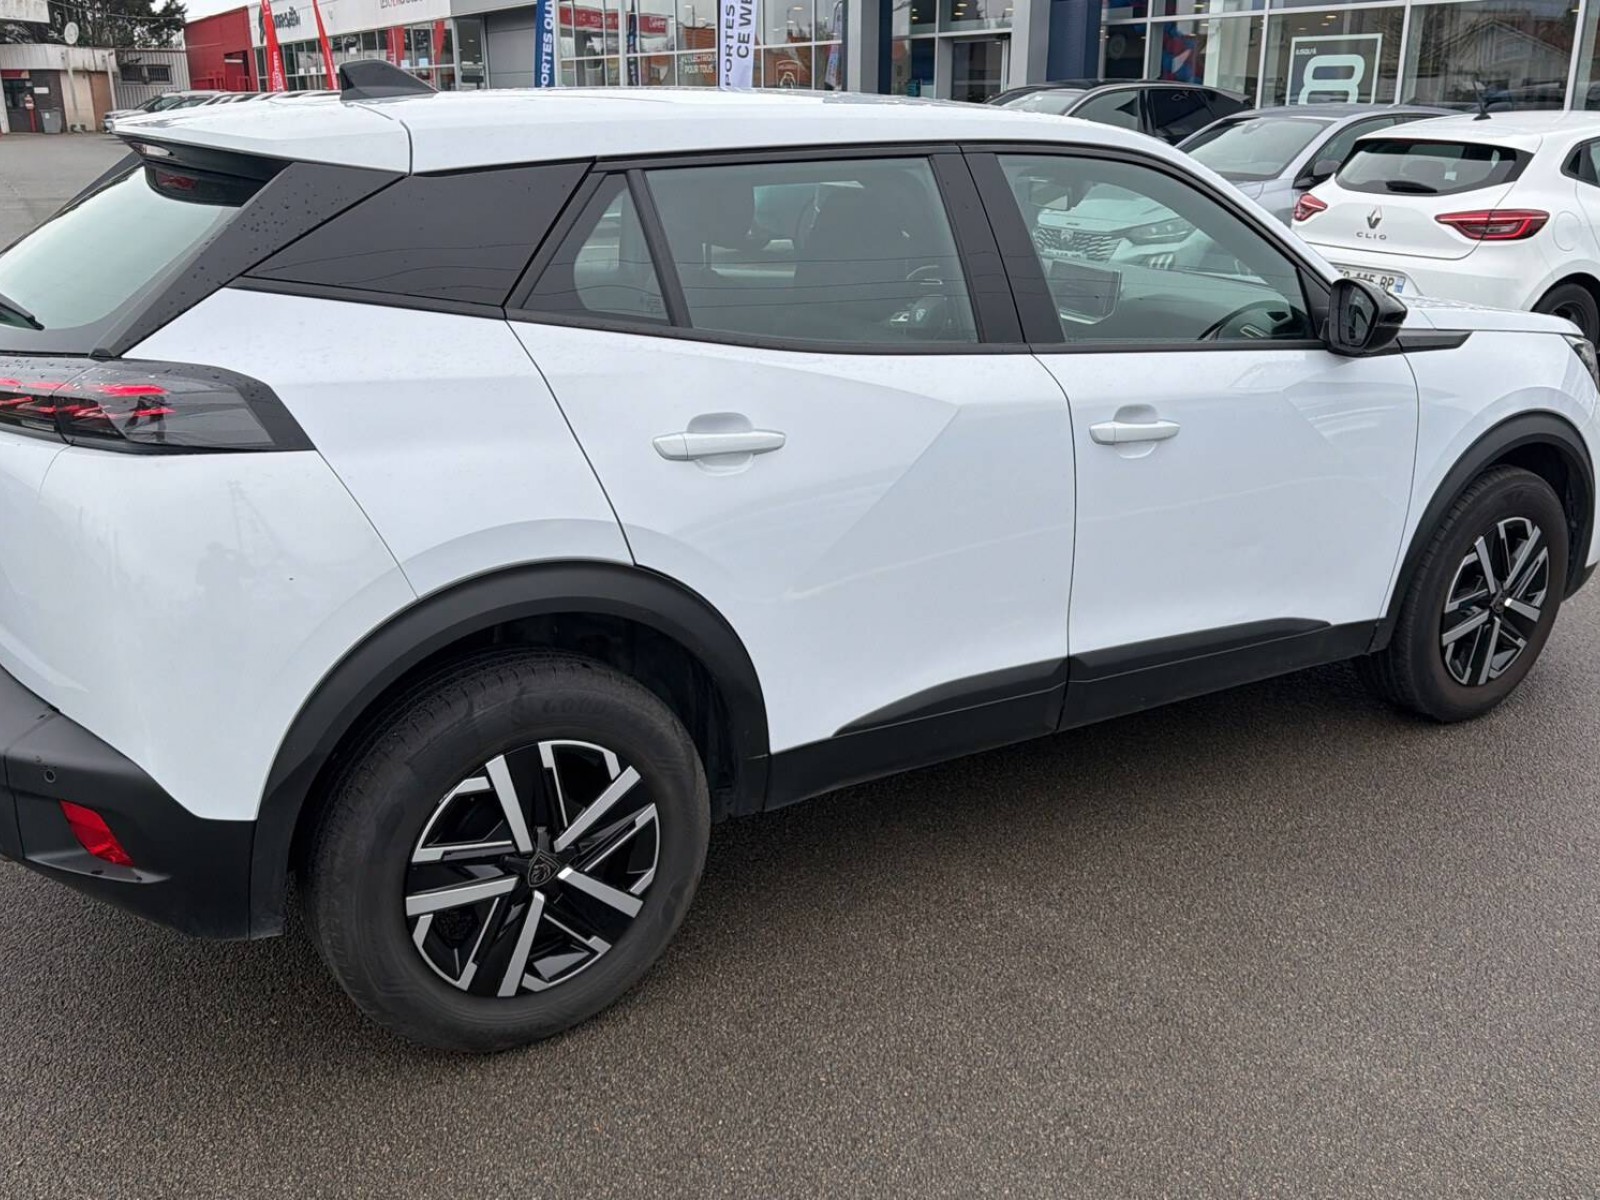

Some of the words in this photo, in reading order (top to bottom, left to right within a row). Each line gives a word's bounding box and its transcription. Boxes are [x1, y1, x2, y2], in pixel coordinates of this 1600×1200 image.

[541, 32, 553, 88] ORTES
[725, 4, 735, 87] PORTES
[737, 33, 750, 59] CE
[1356, 231, 1387, 240] CLIO
